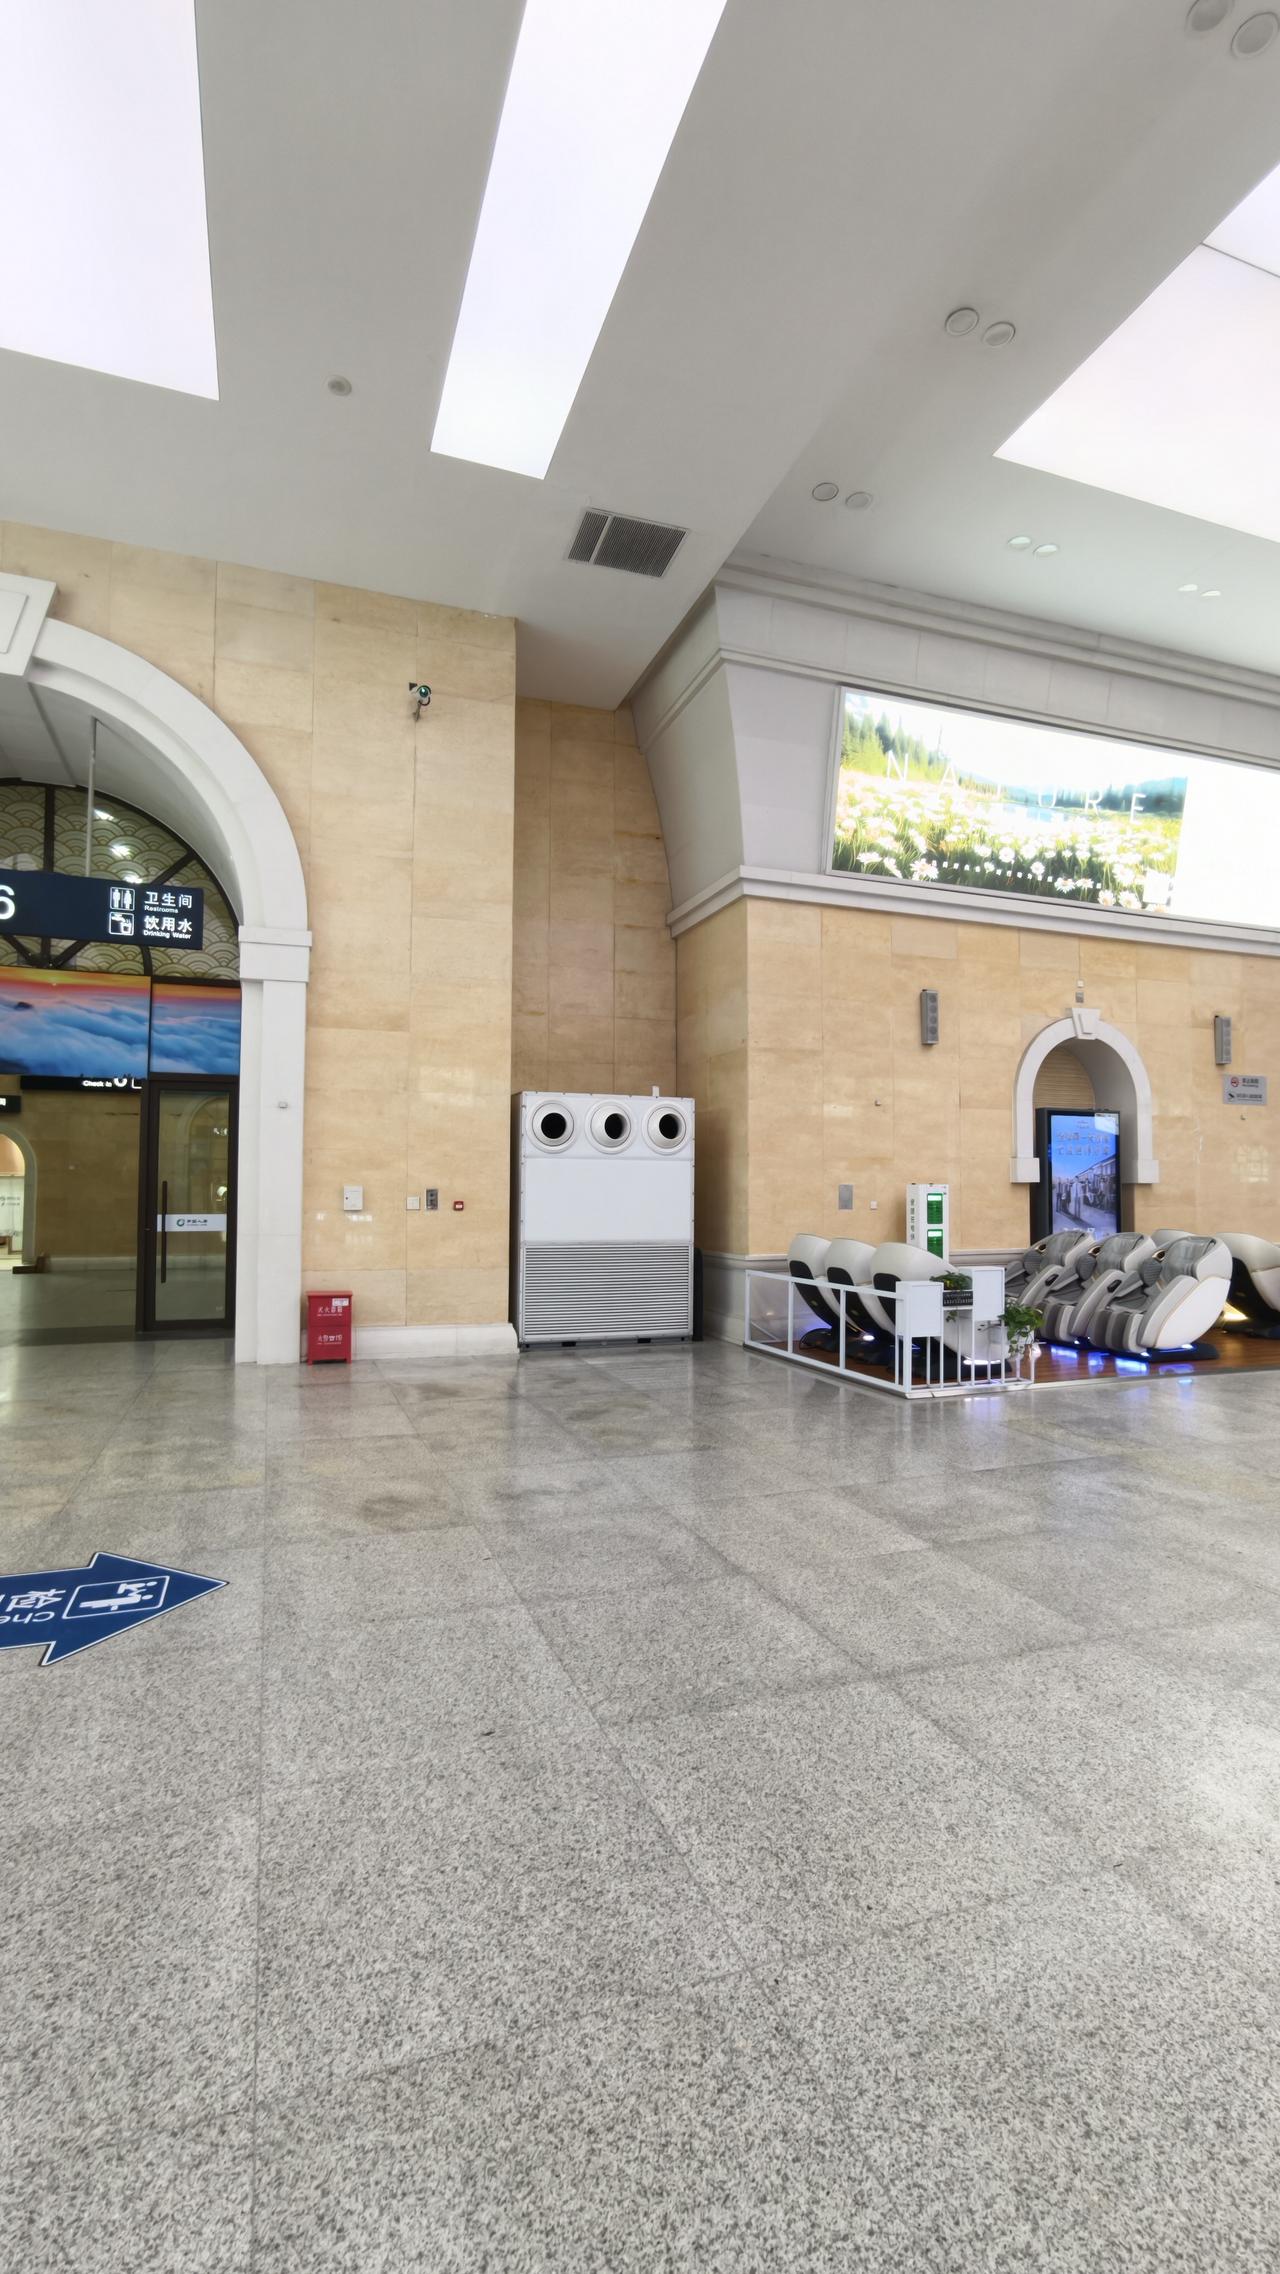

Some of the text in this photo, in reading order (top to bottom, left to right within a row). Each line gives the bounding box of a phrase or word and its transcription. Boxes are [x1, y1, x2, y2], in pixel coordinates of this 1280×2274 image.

[0, 884, 16, 920] 6
[144, 891, 193, 909] 卫生间
[144, 905, 179, 914] Restrooms
[144, 915, 193, 933] 饮用水
[143, 929, 192, 940] Drinking Water
[0, 1588, 67, 1612] 检
